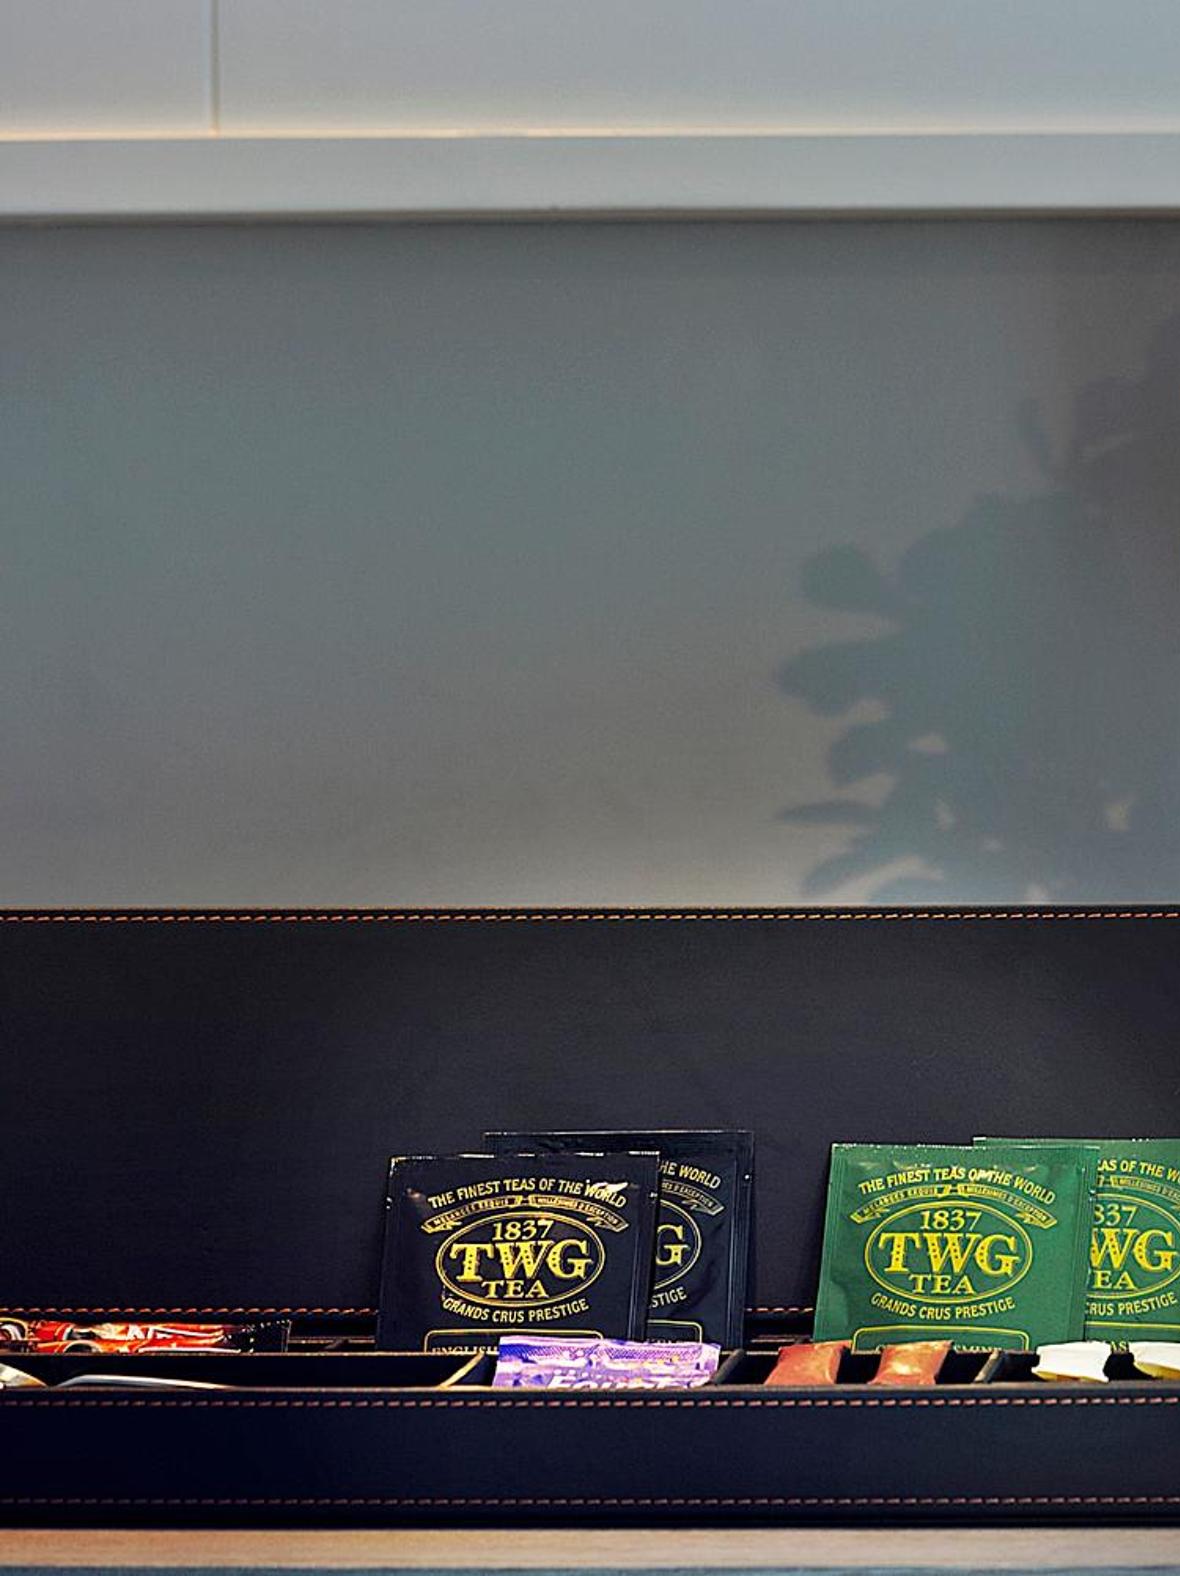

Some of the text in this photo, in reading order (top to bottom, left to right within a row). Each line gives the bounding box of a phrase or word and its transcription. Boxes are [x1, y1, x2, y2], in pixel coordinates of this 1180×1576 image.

[660, 1160, 721, 1189] HE WORLD
[1097, 1159, 1117, 1171] AS
[1120, 1160, 1137, 1172] OF
[1140, 1162, 1165, 1178] THE
[428, 1178, 627, 1208] THE FINEST TEAS OF THE WORLD
[858, 1177, 885, 1195] THE
[886, 1168, 931, 1188] FINEST
[933, 1167, 966, 1181] TEAS
[986, 1169, 1011, 1185] THE
[1014, 1173, 1056, 1205] WORLD
[920, 1210, 982, 1231] 1837
[1094, 1203, 1138, 1226] 837
[492, 1220, 554, 1241] 1837
[450, 1239, 594, 1282] TWG
[878, 1232, 1021, 1277] TWG
[1090, 1228, 1180, 1272] WG
[481, 1279, 550, 1299] TEA
[908, 1273, 975, 1295] TEA
[1092, 1270, 1137, 1290] EA
[651, 1286, 688, 1308] STIGE
[871, 1292, 1016, 1320] GRANDS CRUS PRESTIGE
[1085, 1292, 1178, 1317] RUS PRESTIGE
[442, 1298, 590, 1323] GRANDS CRUS PRESTIGE
